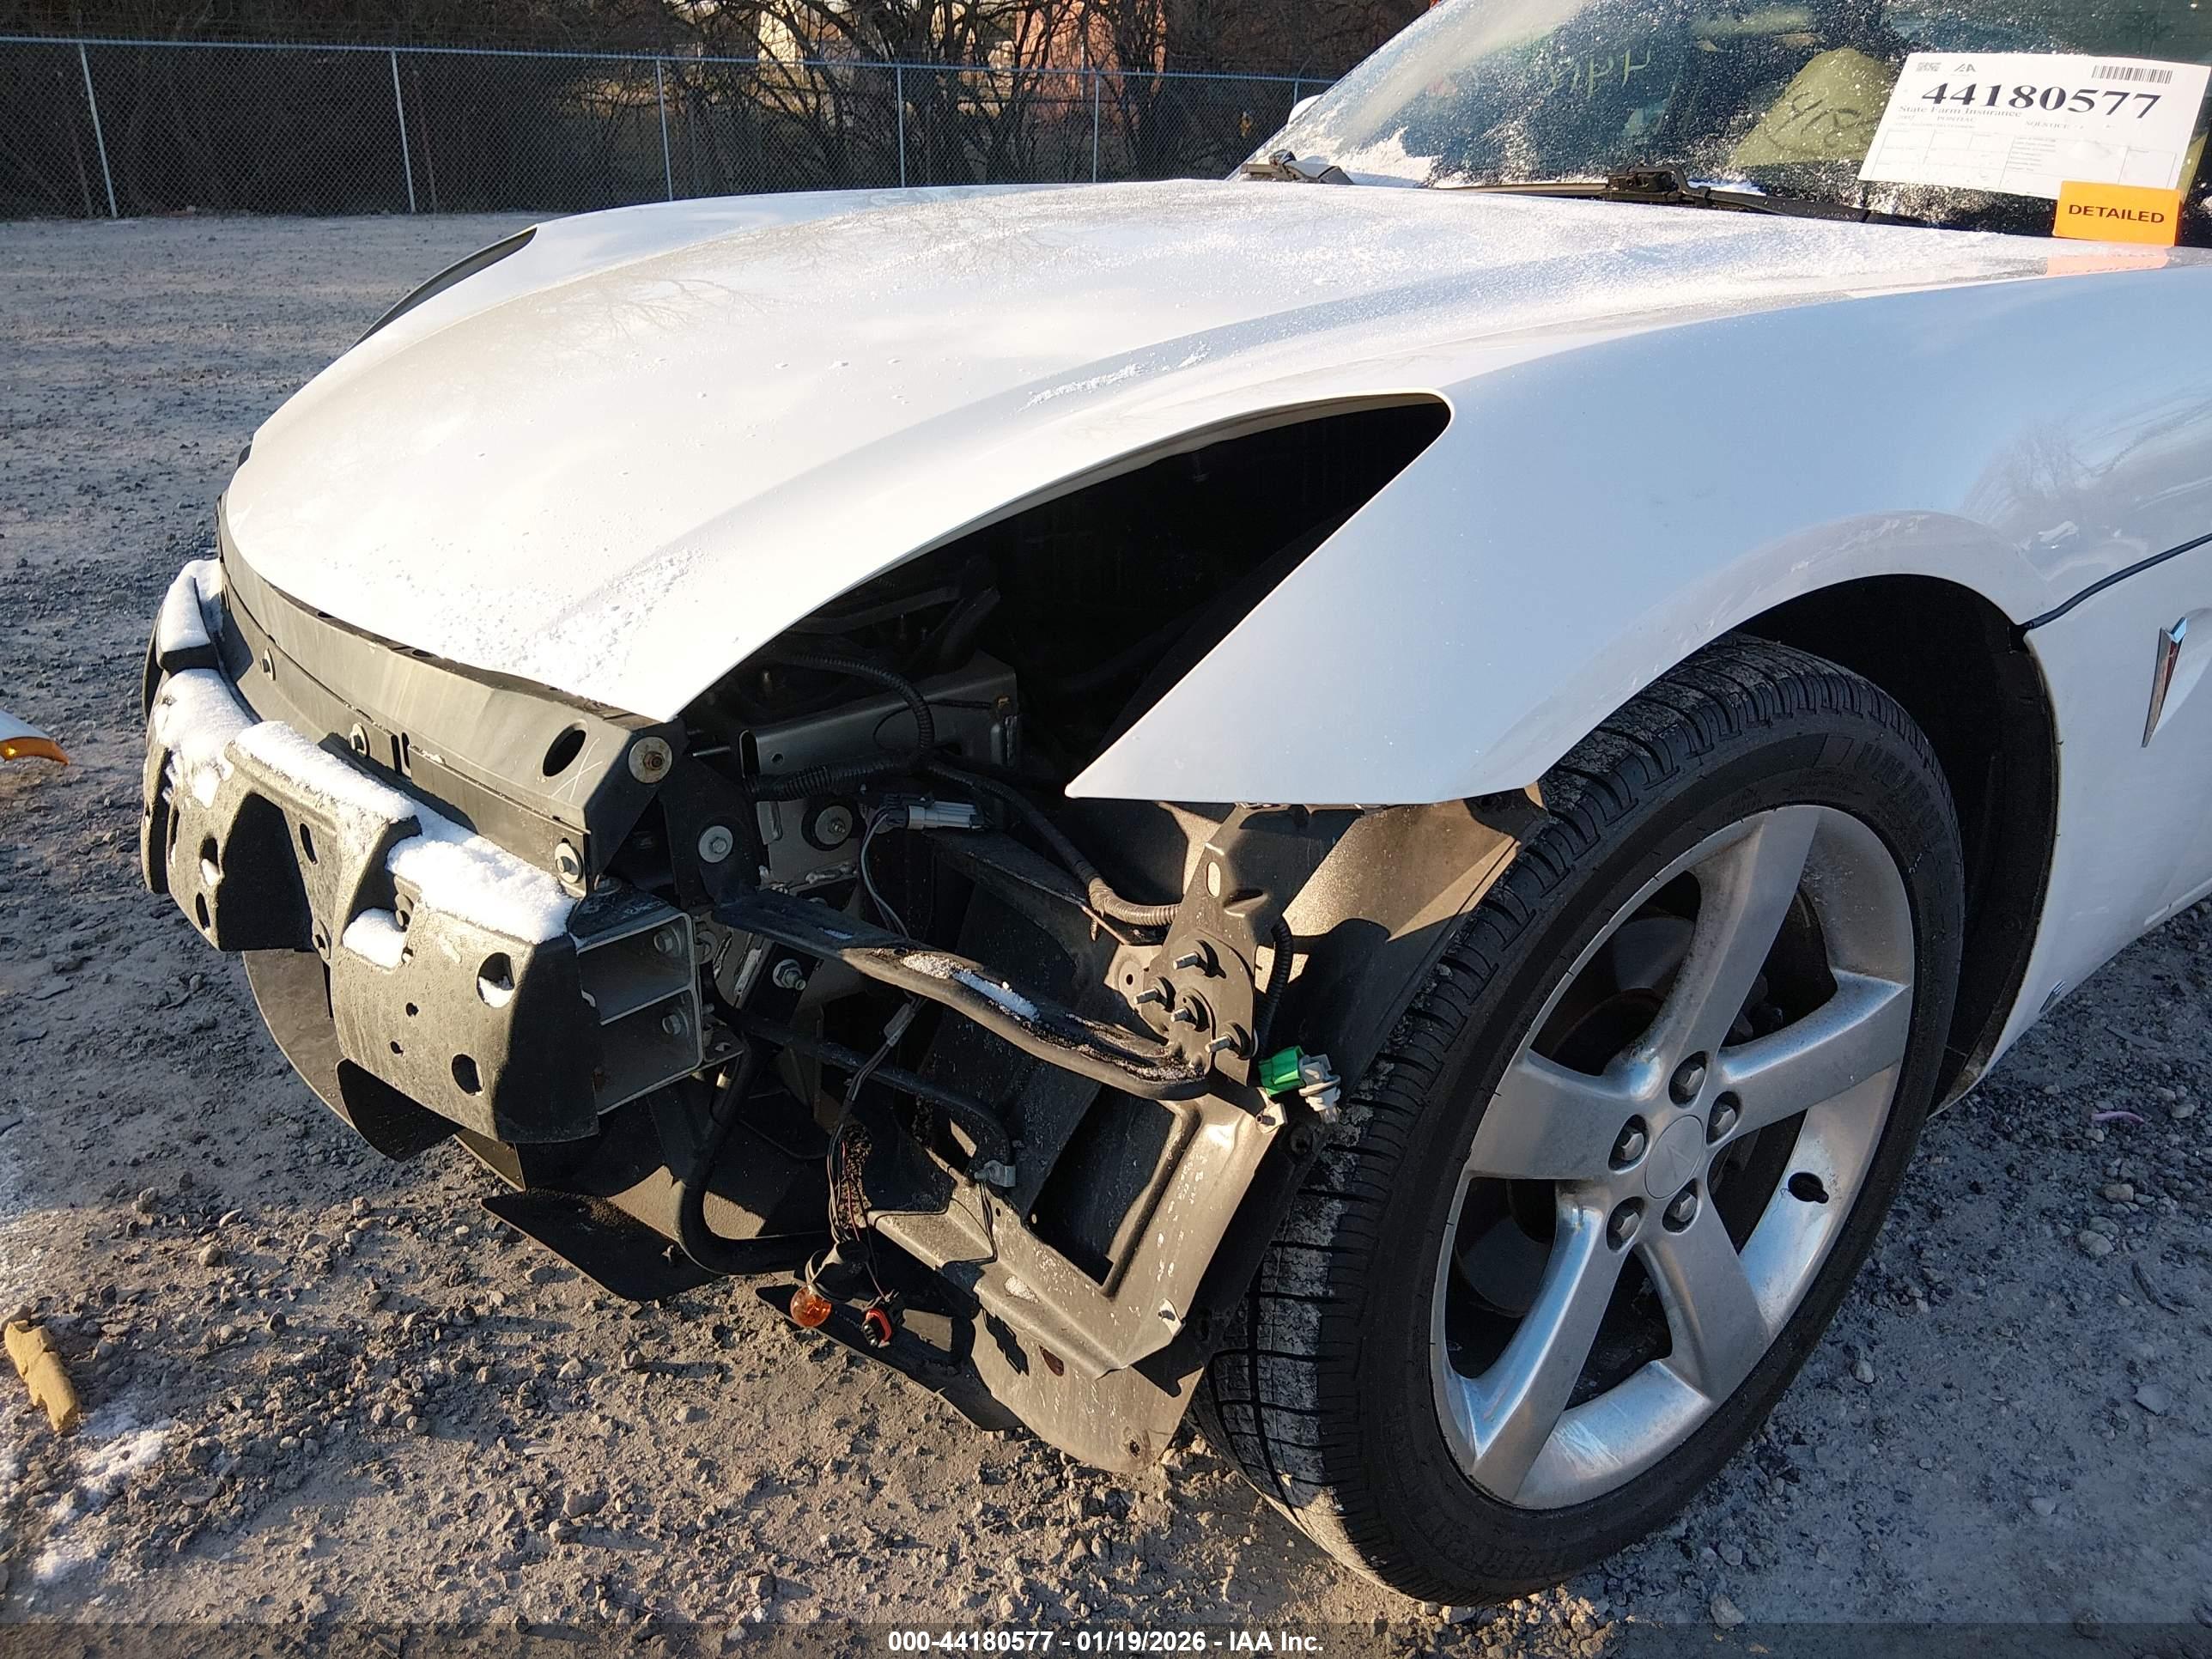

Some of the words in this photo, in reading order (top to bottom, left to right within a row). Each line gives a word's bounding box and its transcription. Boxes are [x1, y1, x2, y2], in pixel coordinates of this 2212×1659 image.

[1922, 82, 2162, 119] 44180577
[1899, 105, 1928, 113] State
[1931, 106, 1961, 115] Farm
[1965, 107, 2022, 118] Insurance
[2068, 204, 2166, 224] DETAILED
